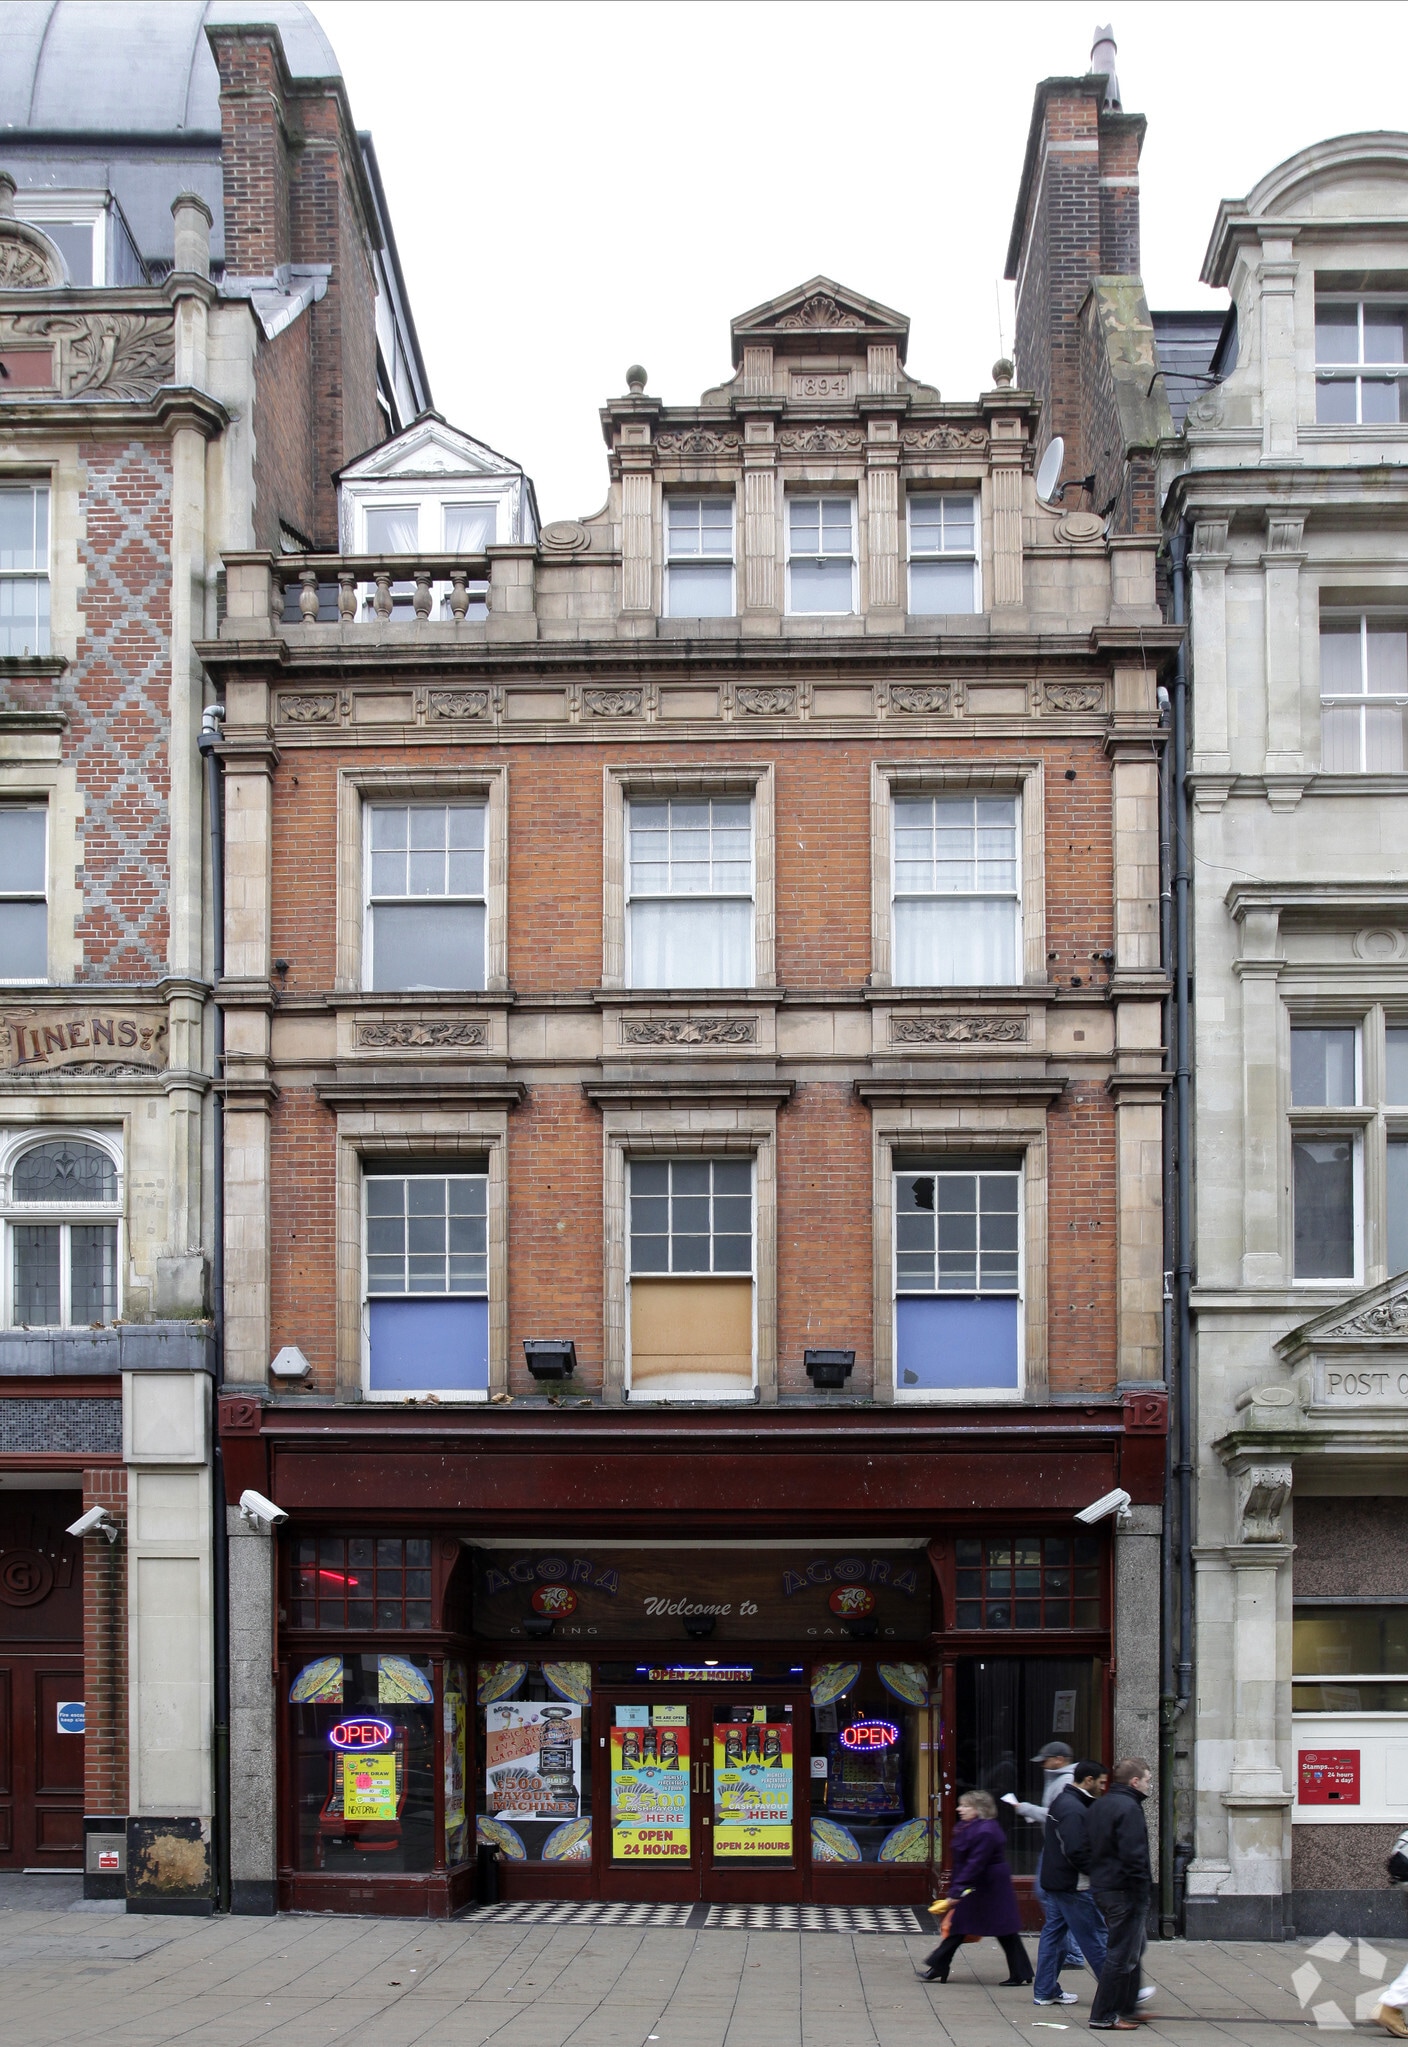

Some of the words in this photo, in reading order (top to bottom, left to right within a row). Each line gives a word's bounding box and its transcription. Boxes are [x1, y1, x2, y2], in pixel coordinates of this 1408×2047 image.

[796, 379, 846, 397] 1894
[11, 1019, 138, 1067] LINENS
[1327, 1373, 1390, 1396] POST
[222, 1404, 254, 1429] 12
[1130, 1402, 1162, 1426] 12
[485, 1559, 620, 1595] AGORA
[783, 1559, 918, 1597] AGORA
[643, 1596, 732, 1616] Welcome
[739, 1600, 758, 1616] to
[651, 1670, 685, 1680] OPEN
[688, 1670, 704, 1680] 24
[706, 1670, 750, 1680] HOURS
[493, 1706, 520, 1714] AGORA
[333, 1725, 388, 1743] OPEN
[844, 1727, 895, 1744] OPEN
[497, 1777, 542, 1790] £500
[493, 1791, 552, 1801] PAYOUT
[616, 1793, 686, 1811] £500
[720, 1790, 789, 1809] £500
[493, 1801, 576, 1812] MACHINES
[749, 1810, 788, 1819] HERE
[646, 1814, 684, 1823] HERE
[638, 1830, 673, 1841] OPEN
[624, 1844, 640, 1855] 24
[643, 1844, 688, 1855] HOURS
[716, 1842, 742, 1850] OPEN
[744, 1842, 756, 1850] 24
[758, 1842, 790, 1850] HOURS
